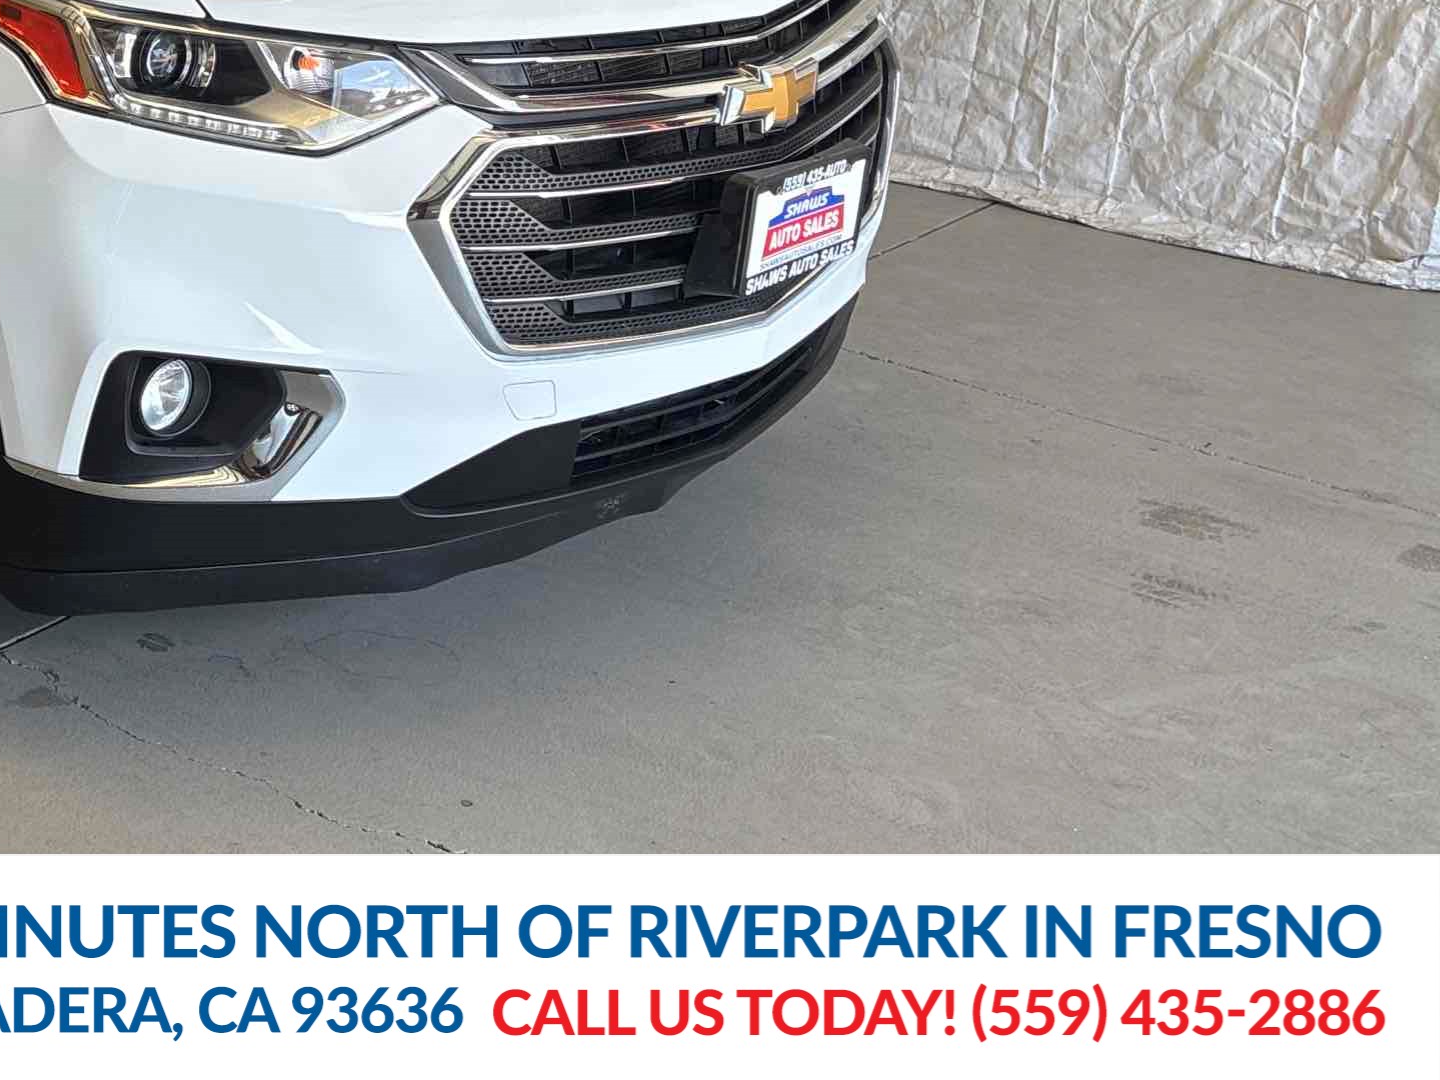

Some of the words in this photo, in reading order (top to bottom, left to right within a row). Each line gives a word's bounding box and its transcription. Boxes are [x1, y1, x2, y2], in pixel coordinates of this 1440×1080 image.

[784, 192, 830, 219] SHAWS
[769, 224, 800, 251] AUTO
[803, 209, 840, 238] SALES
[746, 265, 788, 295] SHAWS
[789, 253, 817, 278] AUTO
[820, 240, 855, 265] SALES
